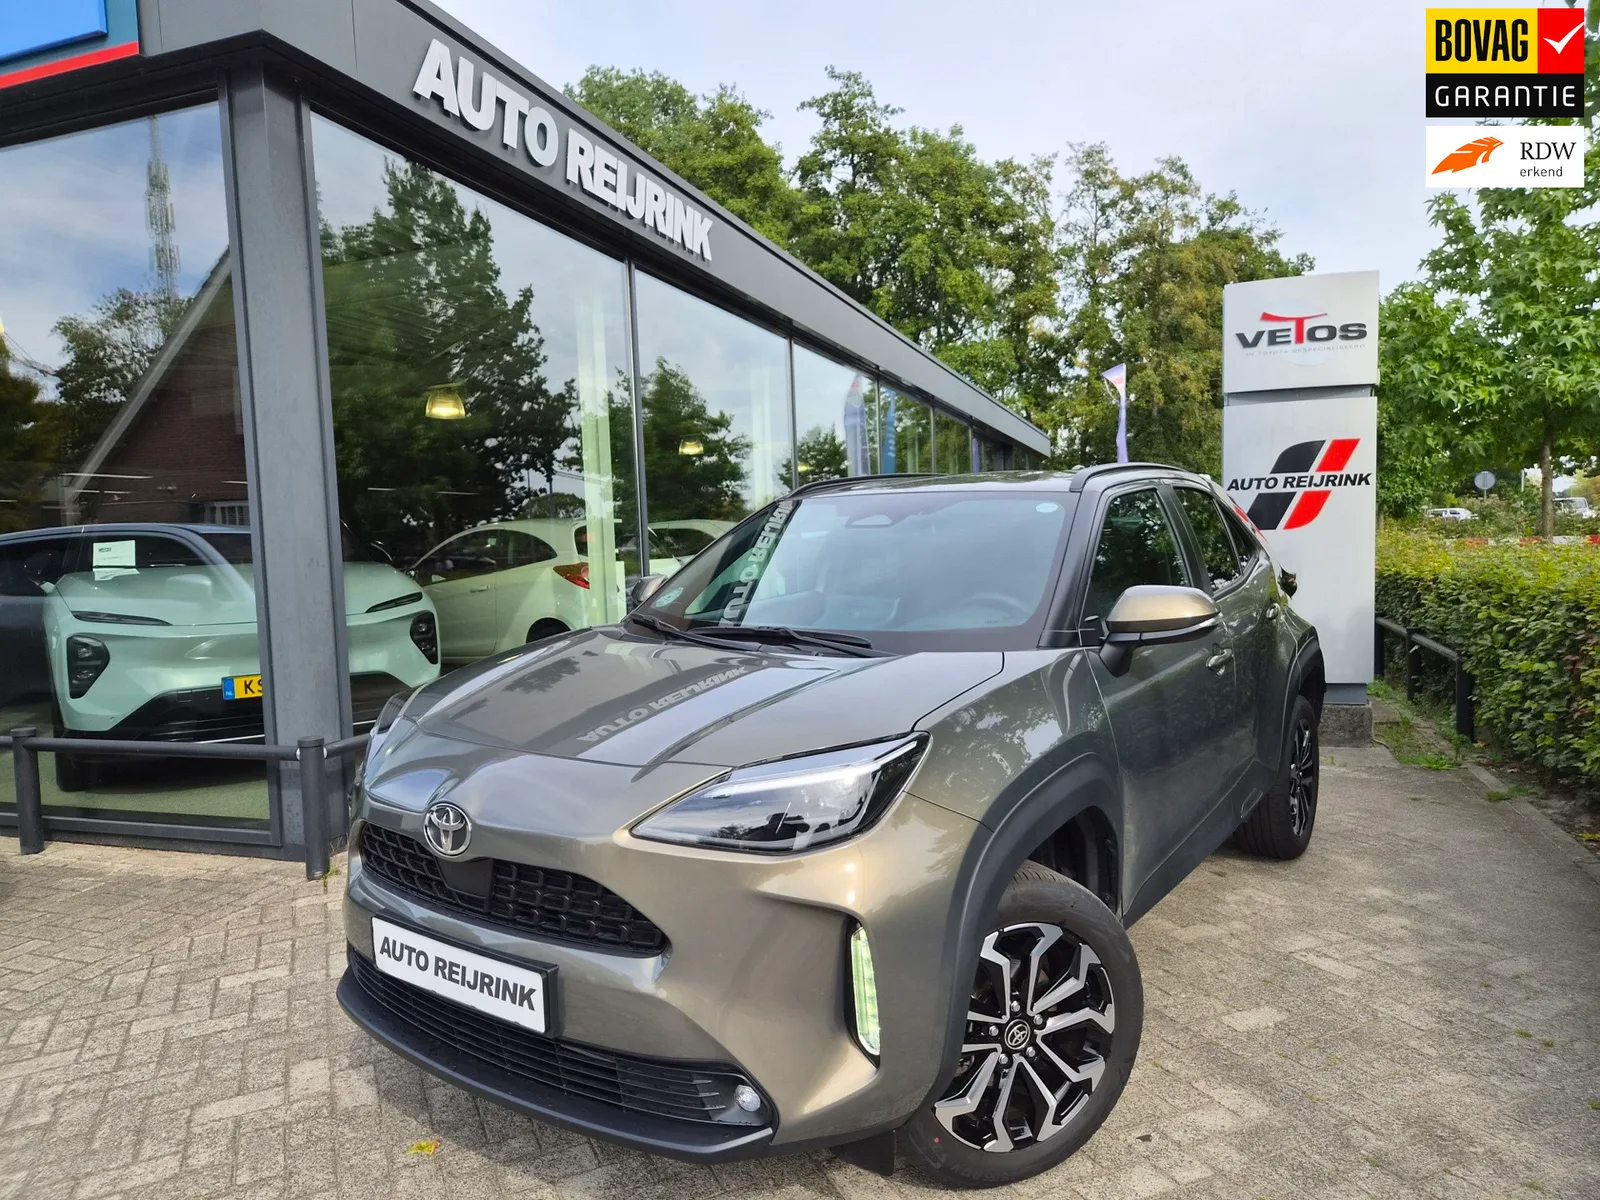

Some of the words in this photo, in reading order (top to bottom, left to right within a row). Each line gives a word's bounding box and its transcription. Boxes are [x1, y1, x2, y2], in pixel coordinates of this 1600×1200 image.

[412, 38, 559, 167] AUTO
[566, 128, 713, 261] REIJRINK
[1235, 312, 1368, 349] VETOS
[1227, 476, 1278, 491] AUTO
[1283, 472, 1372, 488] REIJRINK
[379, 936, 430, 972] AUTO
[434, 956, 537, 1011] REIJRINK
